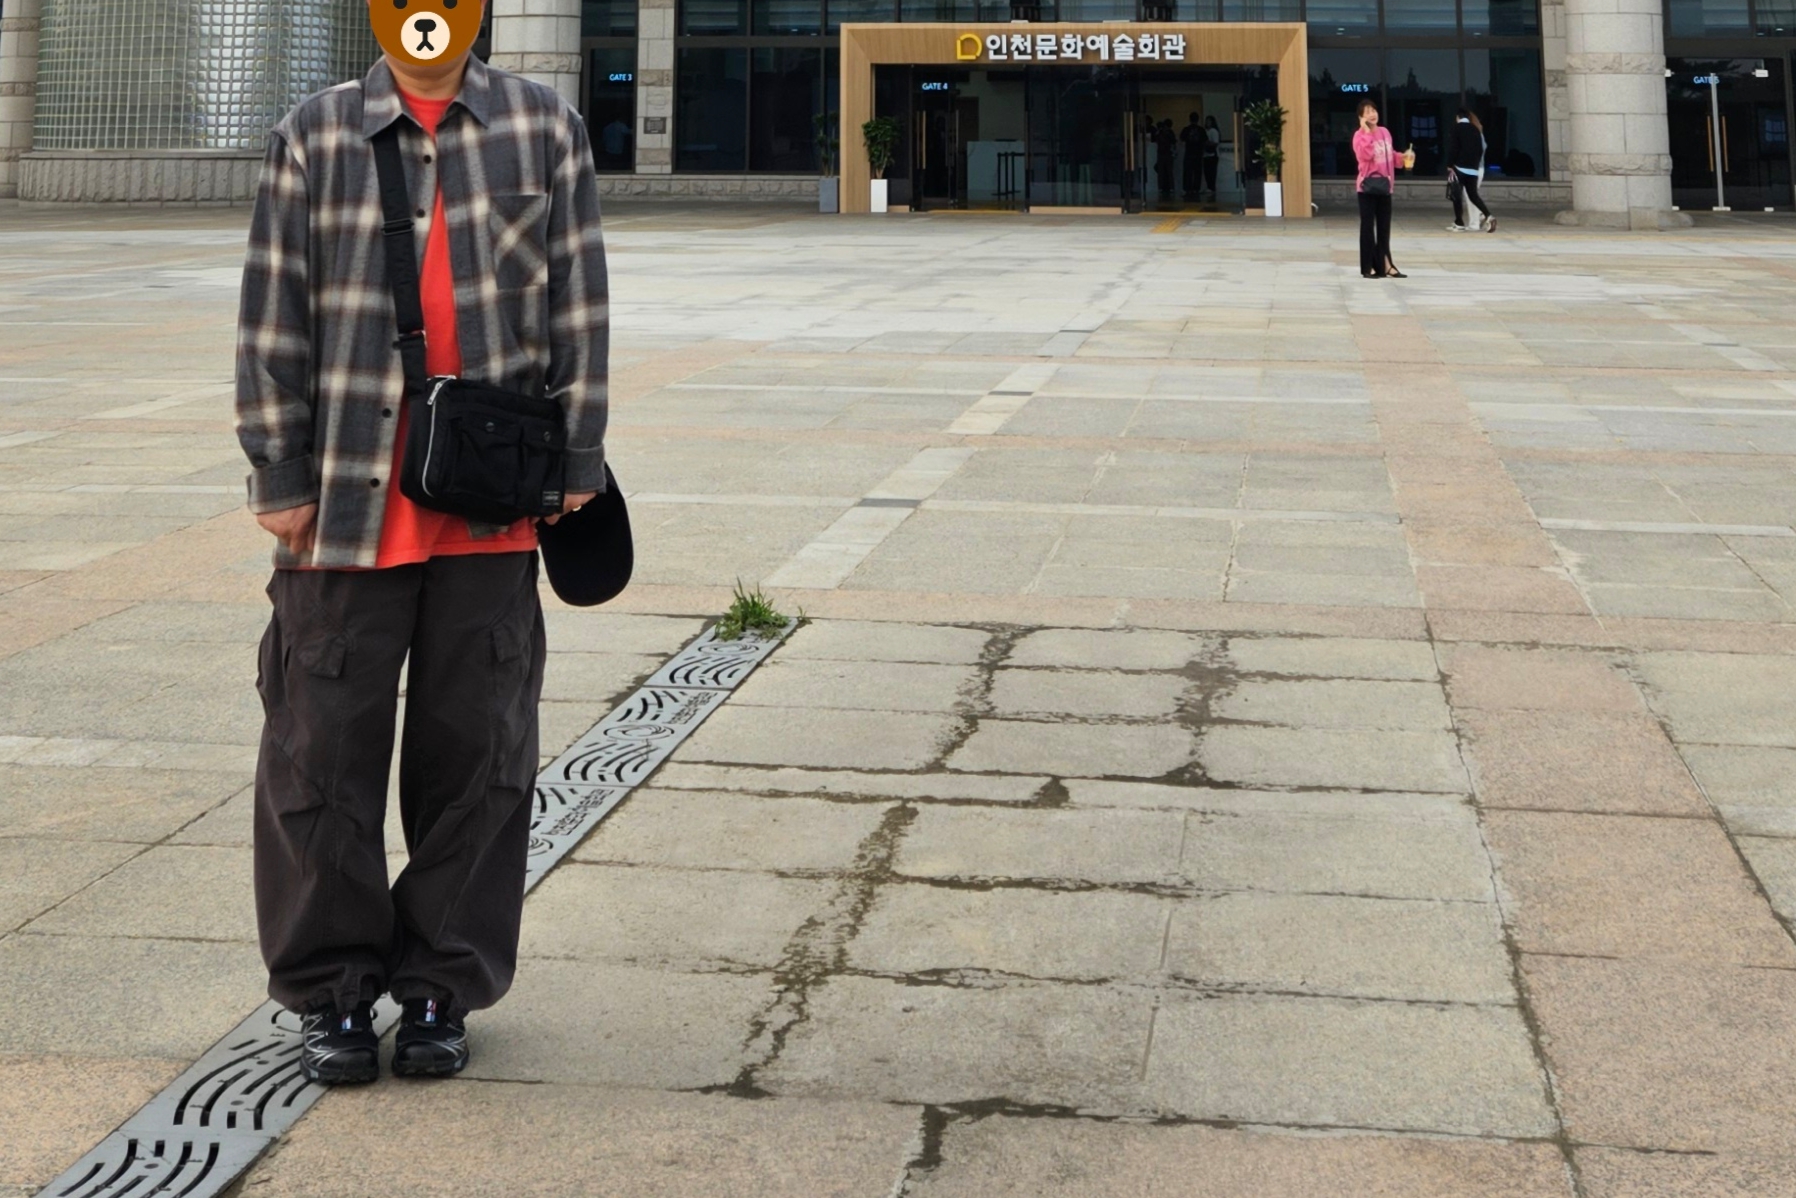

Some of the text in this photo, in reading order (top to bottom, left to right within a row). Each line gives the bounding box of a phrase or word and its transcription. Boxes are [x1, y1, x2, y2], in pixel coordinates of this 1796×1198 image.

[986, 33, 1186, 60] 인천문화예술회관
[609, 73, 627, 81] GATE
[921, 82, 941, 90] GATE
[1341, 83, 1369, 92] GATE 5
